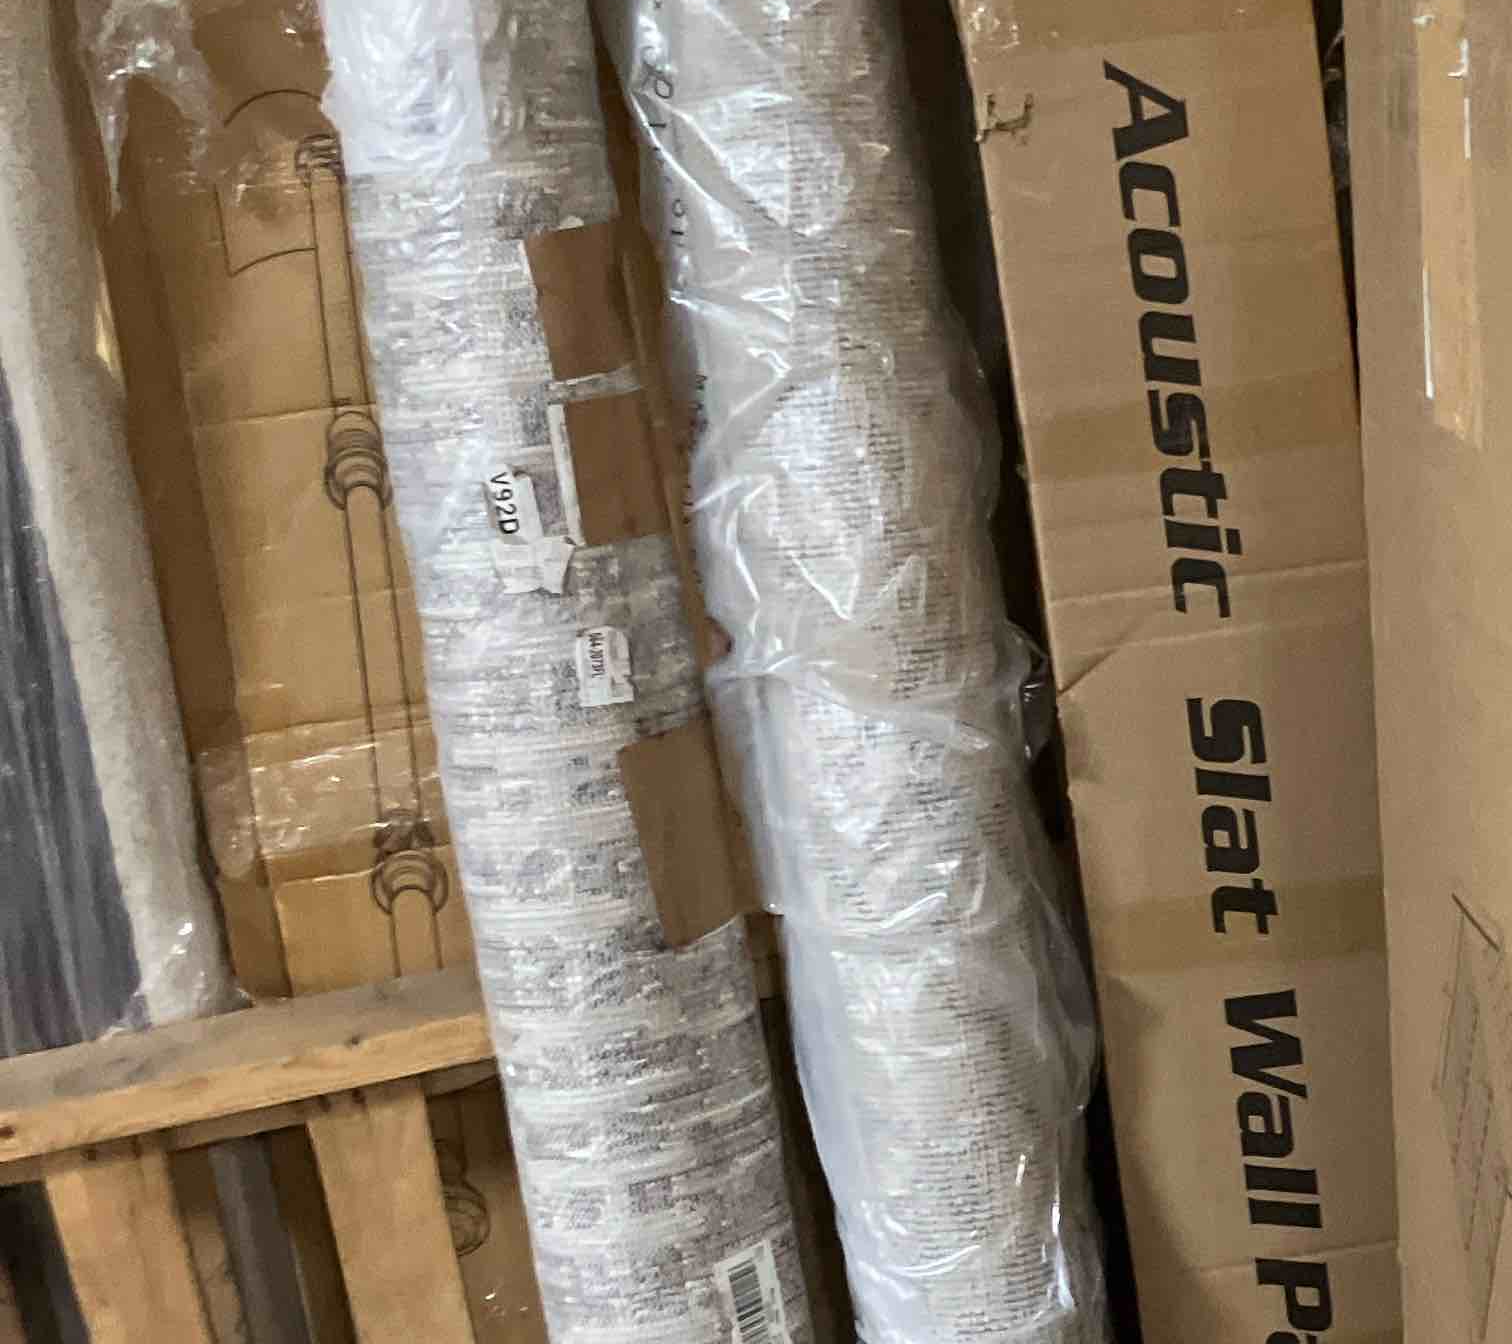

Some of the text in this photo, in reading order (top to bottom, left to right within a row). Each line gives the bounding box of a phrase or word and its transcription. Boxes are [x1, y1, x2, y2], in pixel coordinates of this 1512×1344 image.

[1103, 60, 1243, 619] Acoustic
[1185, 696, 1273, 937] Slat
[1224, 989, 1324, 1231] Wall
